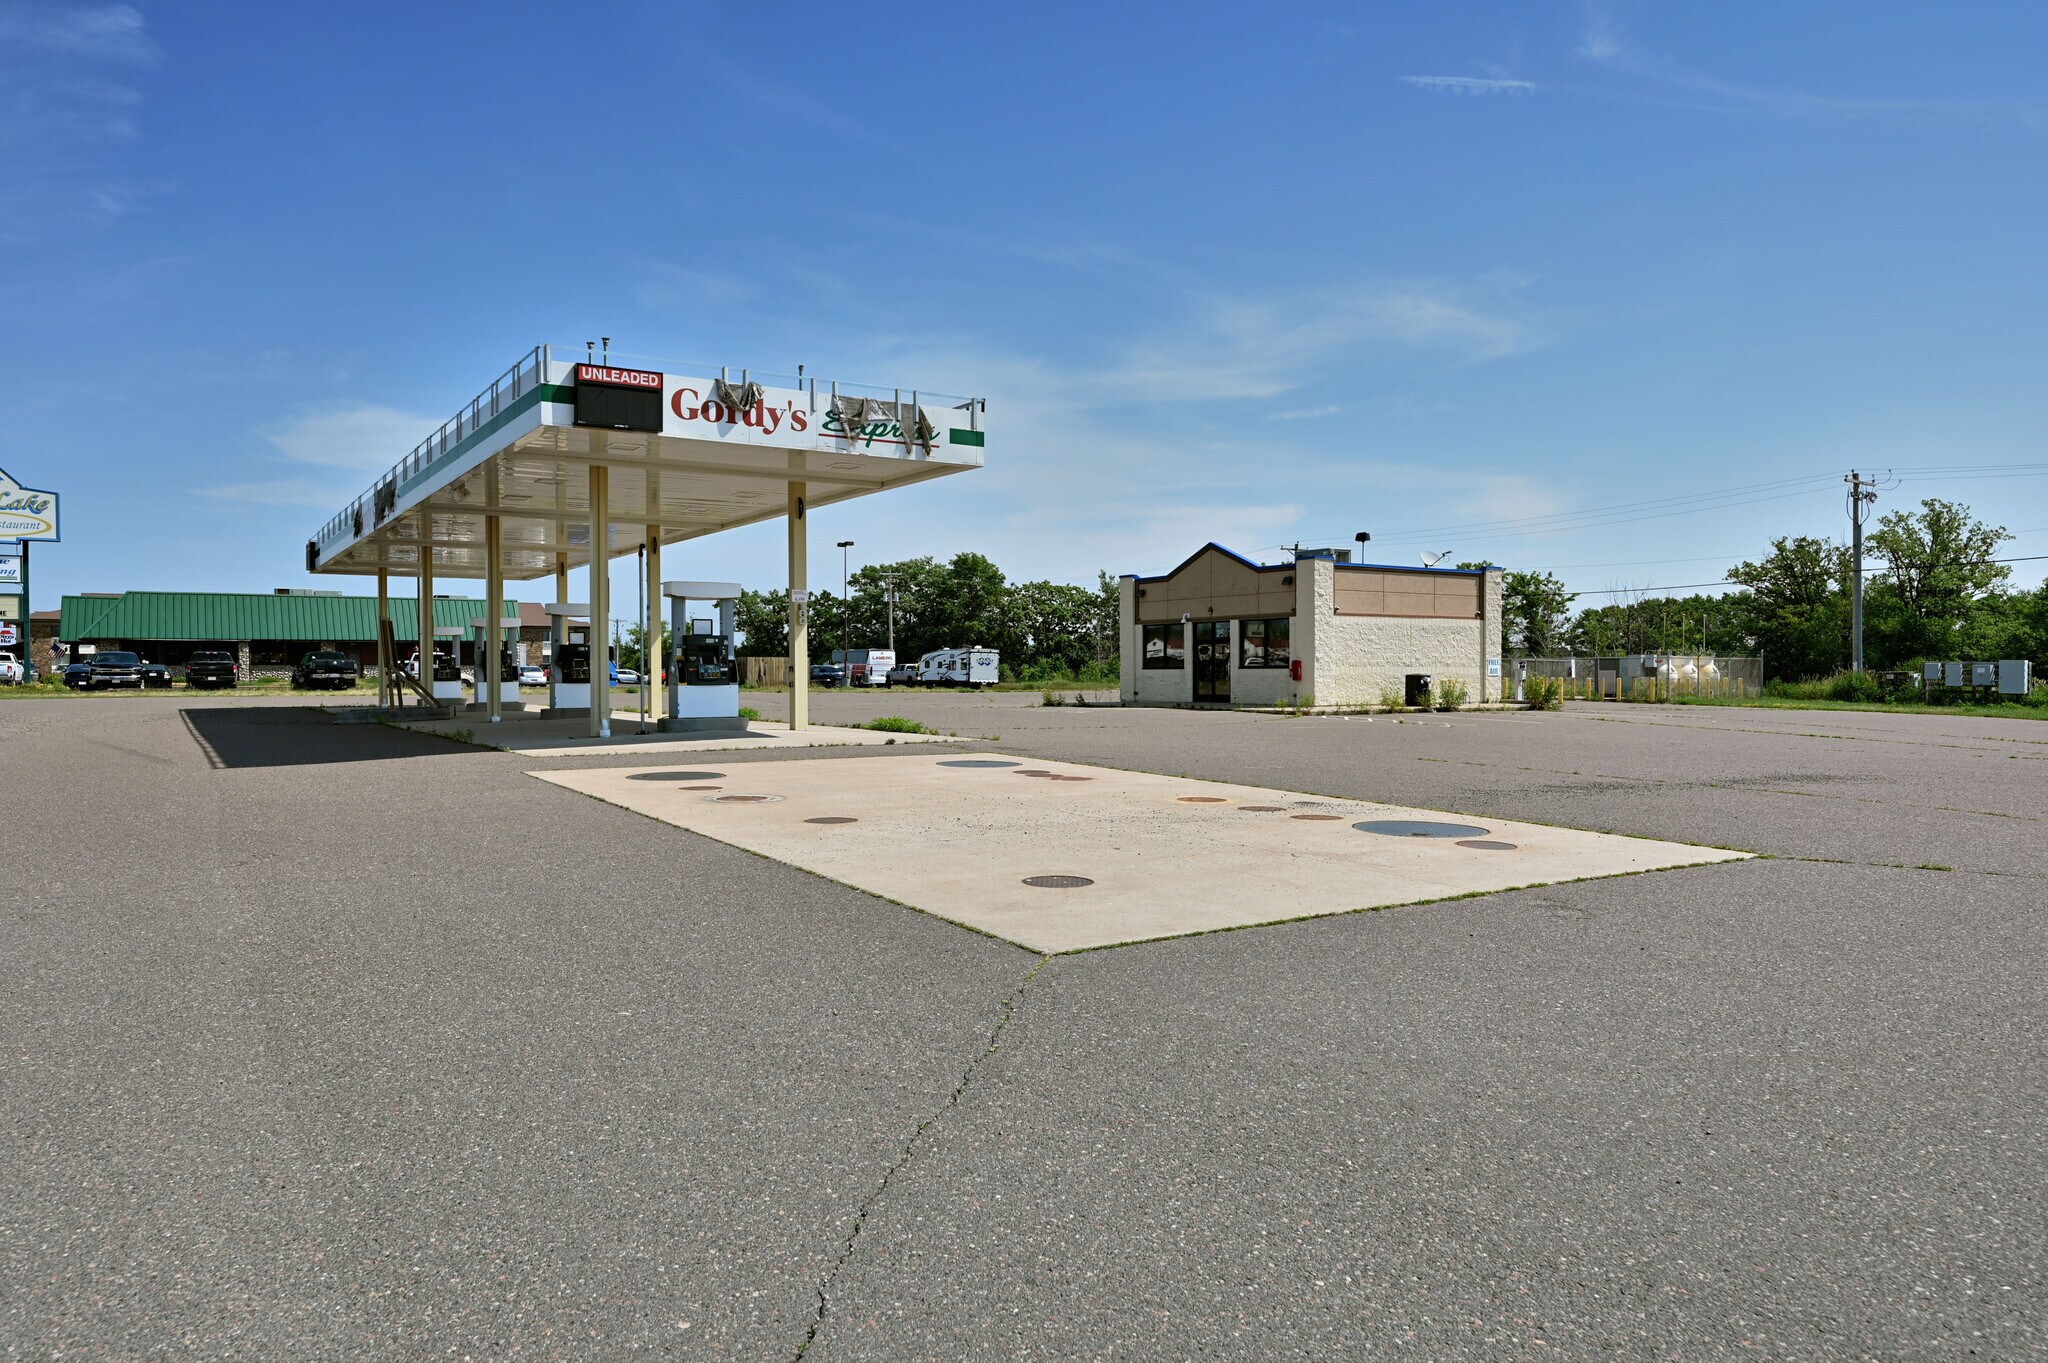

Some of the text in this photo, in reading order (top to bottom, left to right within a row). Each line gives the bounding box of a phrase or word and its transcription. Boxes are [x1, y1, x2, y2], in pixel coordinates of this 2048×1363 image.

[582, 366, 659, 386] UNLEADED
[671, 388, 808, 436] Gordy's
[0, 491, 51, 514] Lake
